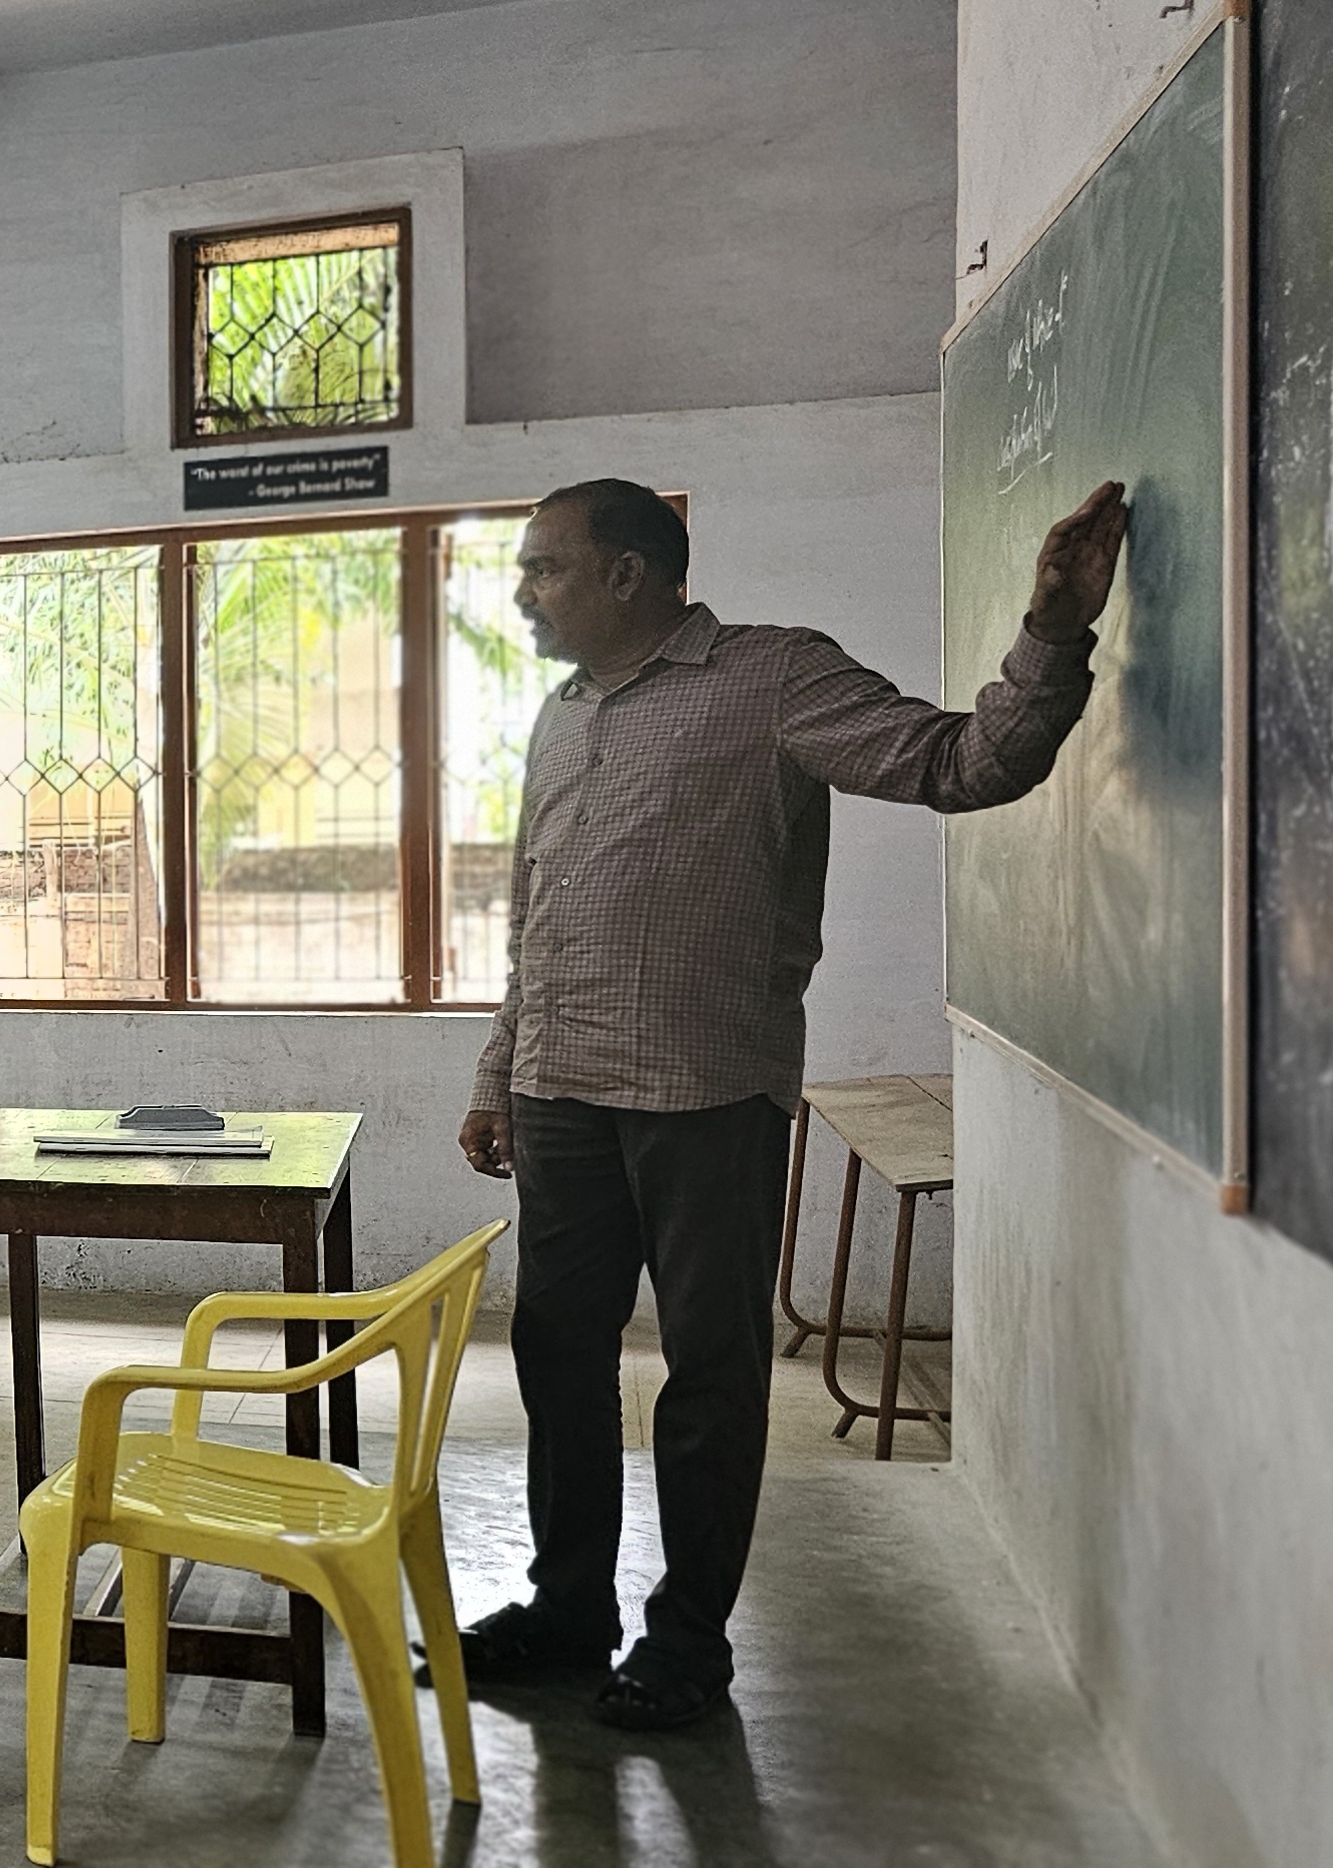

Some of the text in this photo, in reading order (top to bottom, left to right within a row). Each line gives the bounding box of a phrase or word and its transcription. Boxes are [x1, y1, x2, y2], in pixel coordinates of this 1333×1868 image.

[252, 462, 264, 477] of
[319, 457, 329, 472] is
[256, 483, 296, 499] George
[299, 479, 342, 496] Bernard
[344, 477, 375, 492] Shaw
